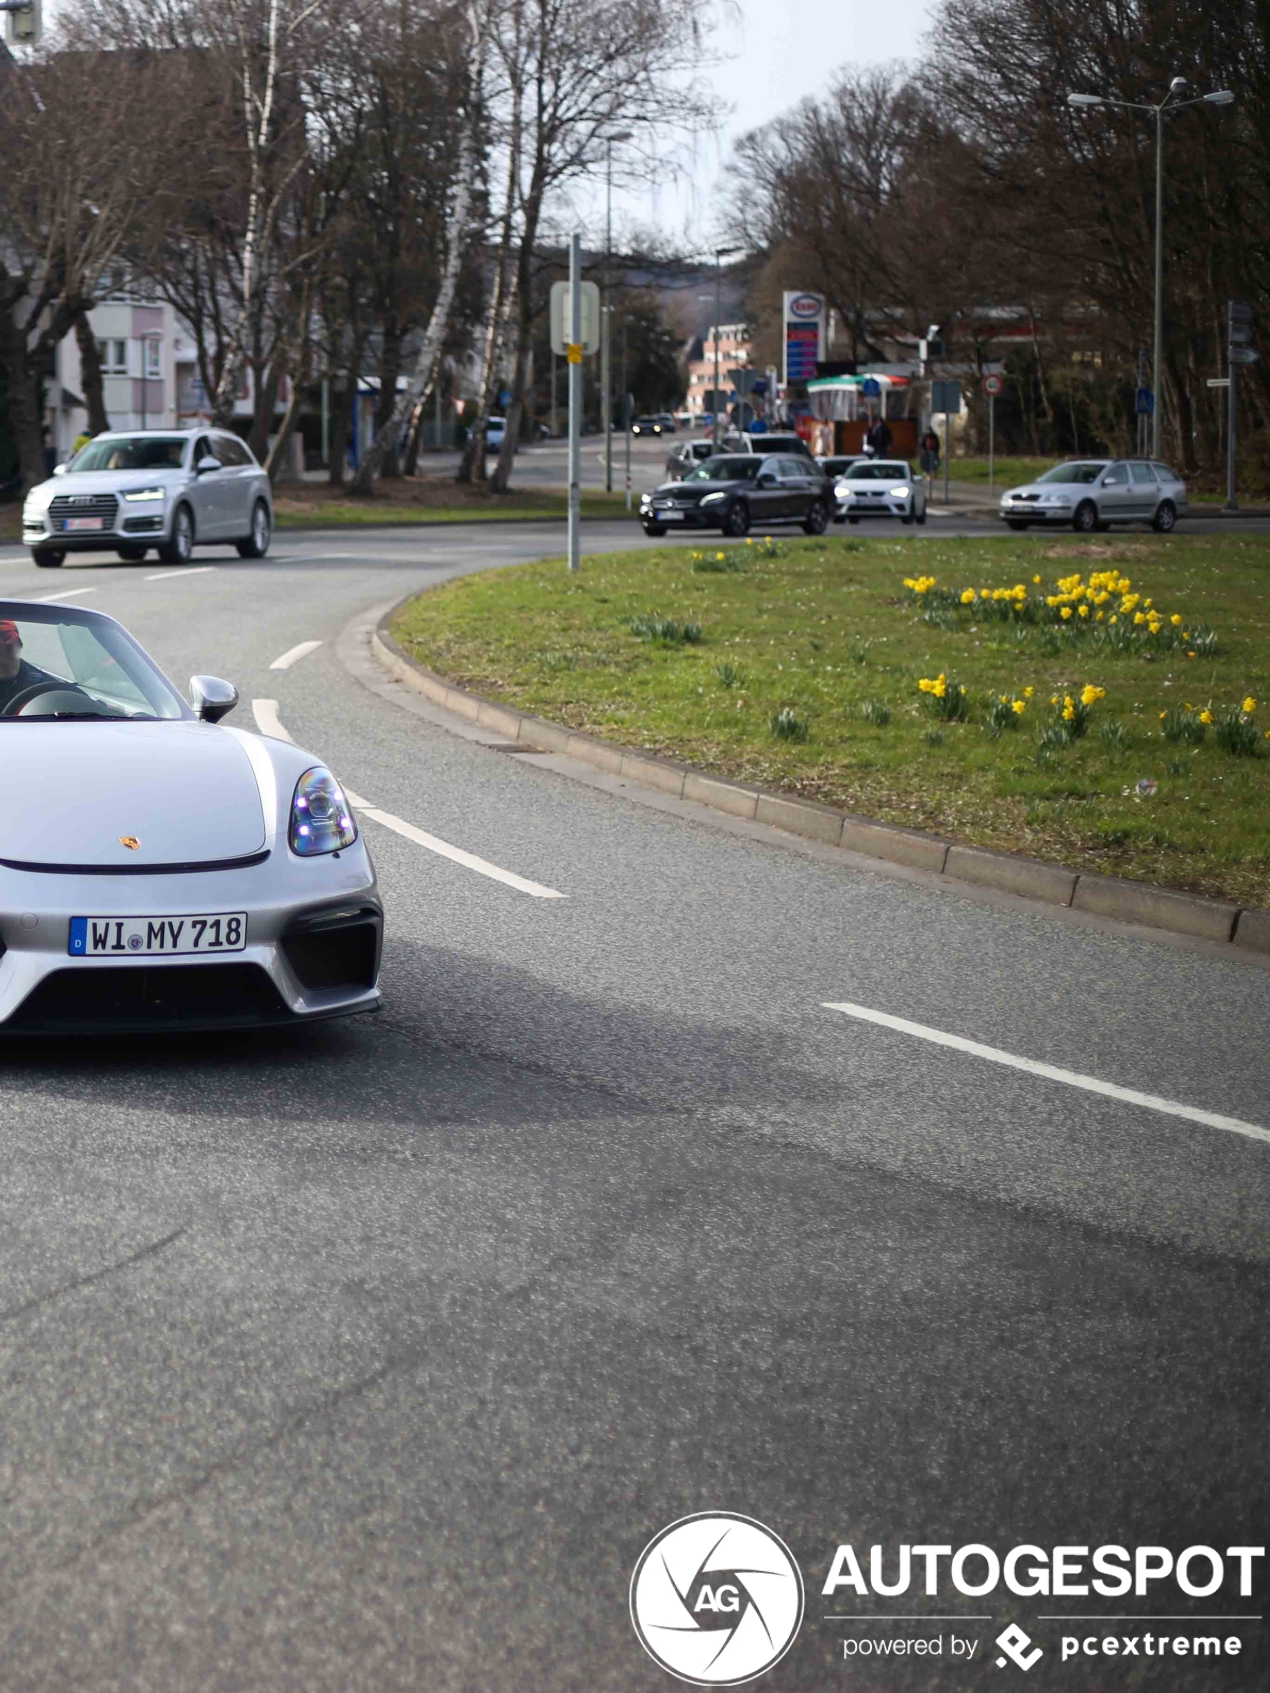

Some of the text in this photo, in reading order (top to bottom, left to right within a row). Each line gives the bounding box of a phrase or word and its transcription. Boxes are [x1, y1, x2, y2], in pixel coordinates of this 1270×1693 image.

[92, 922, 125, 950] WI
[147, 921, 184, 949] MY
[191, 917, 241, 948] 718
